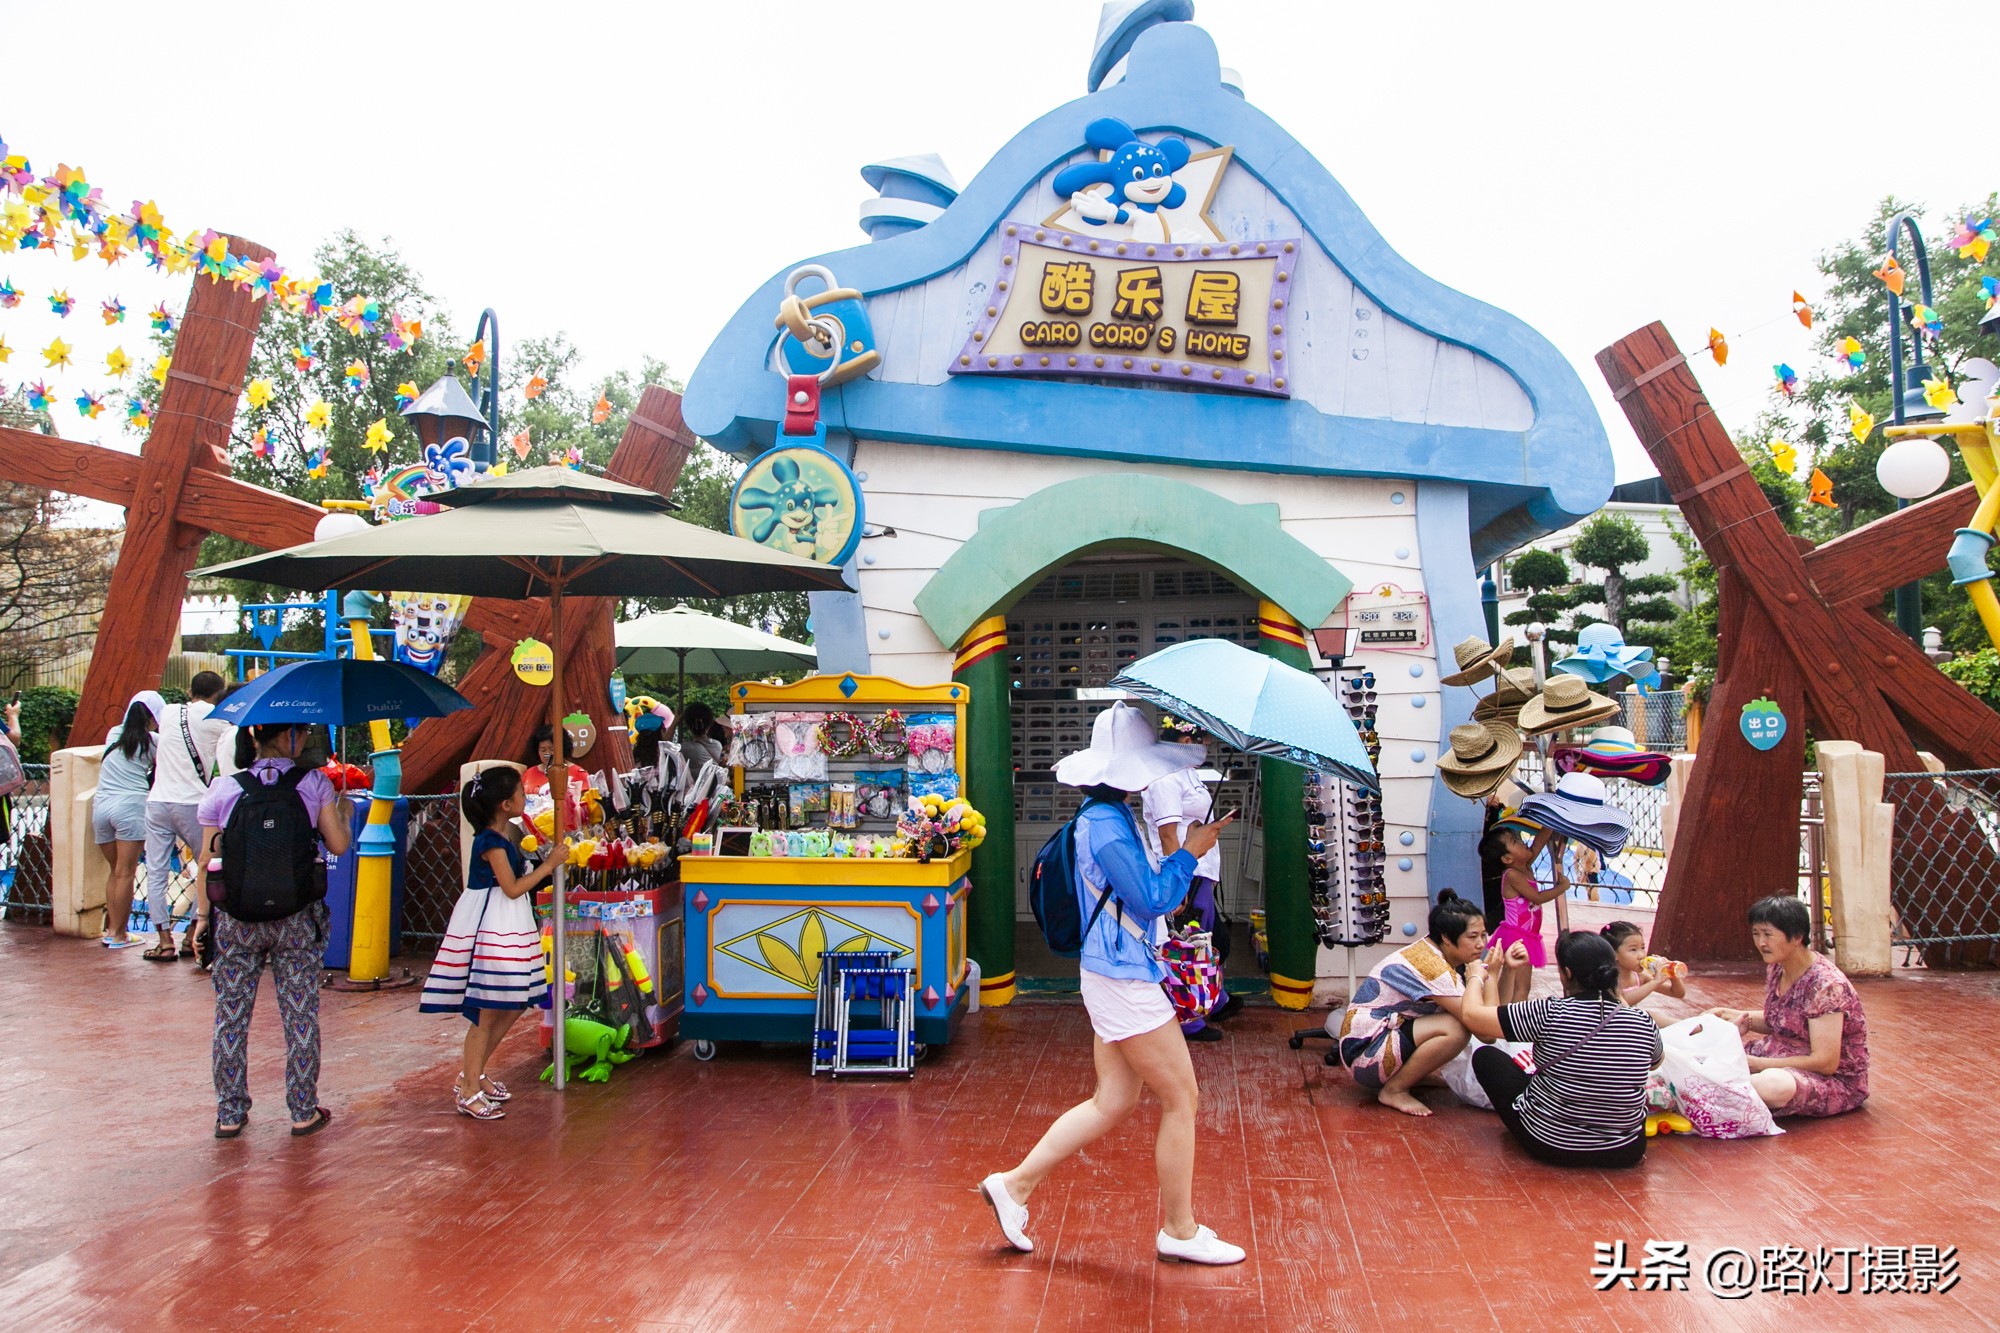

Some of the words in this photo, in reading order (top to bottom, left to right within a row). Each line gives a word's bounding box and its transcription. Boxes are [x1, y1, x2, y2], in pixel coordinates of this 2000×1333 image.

[1040, 261, 1242, 326] 酷乐屋
[1020, 321, 1081, 347] CARO
[1186, 329, 1250, 360] HOME
[270, 700, 289, 708] Let's
[367, 704, 401, 712] Dulux
[1748, 717, 1779, 729] 出口
[1766, 730, 1778, 738] OUT
